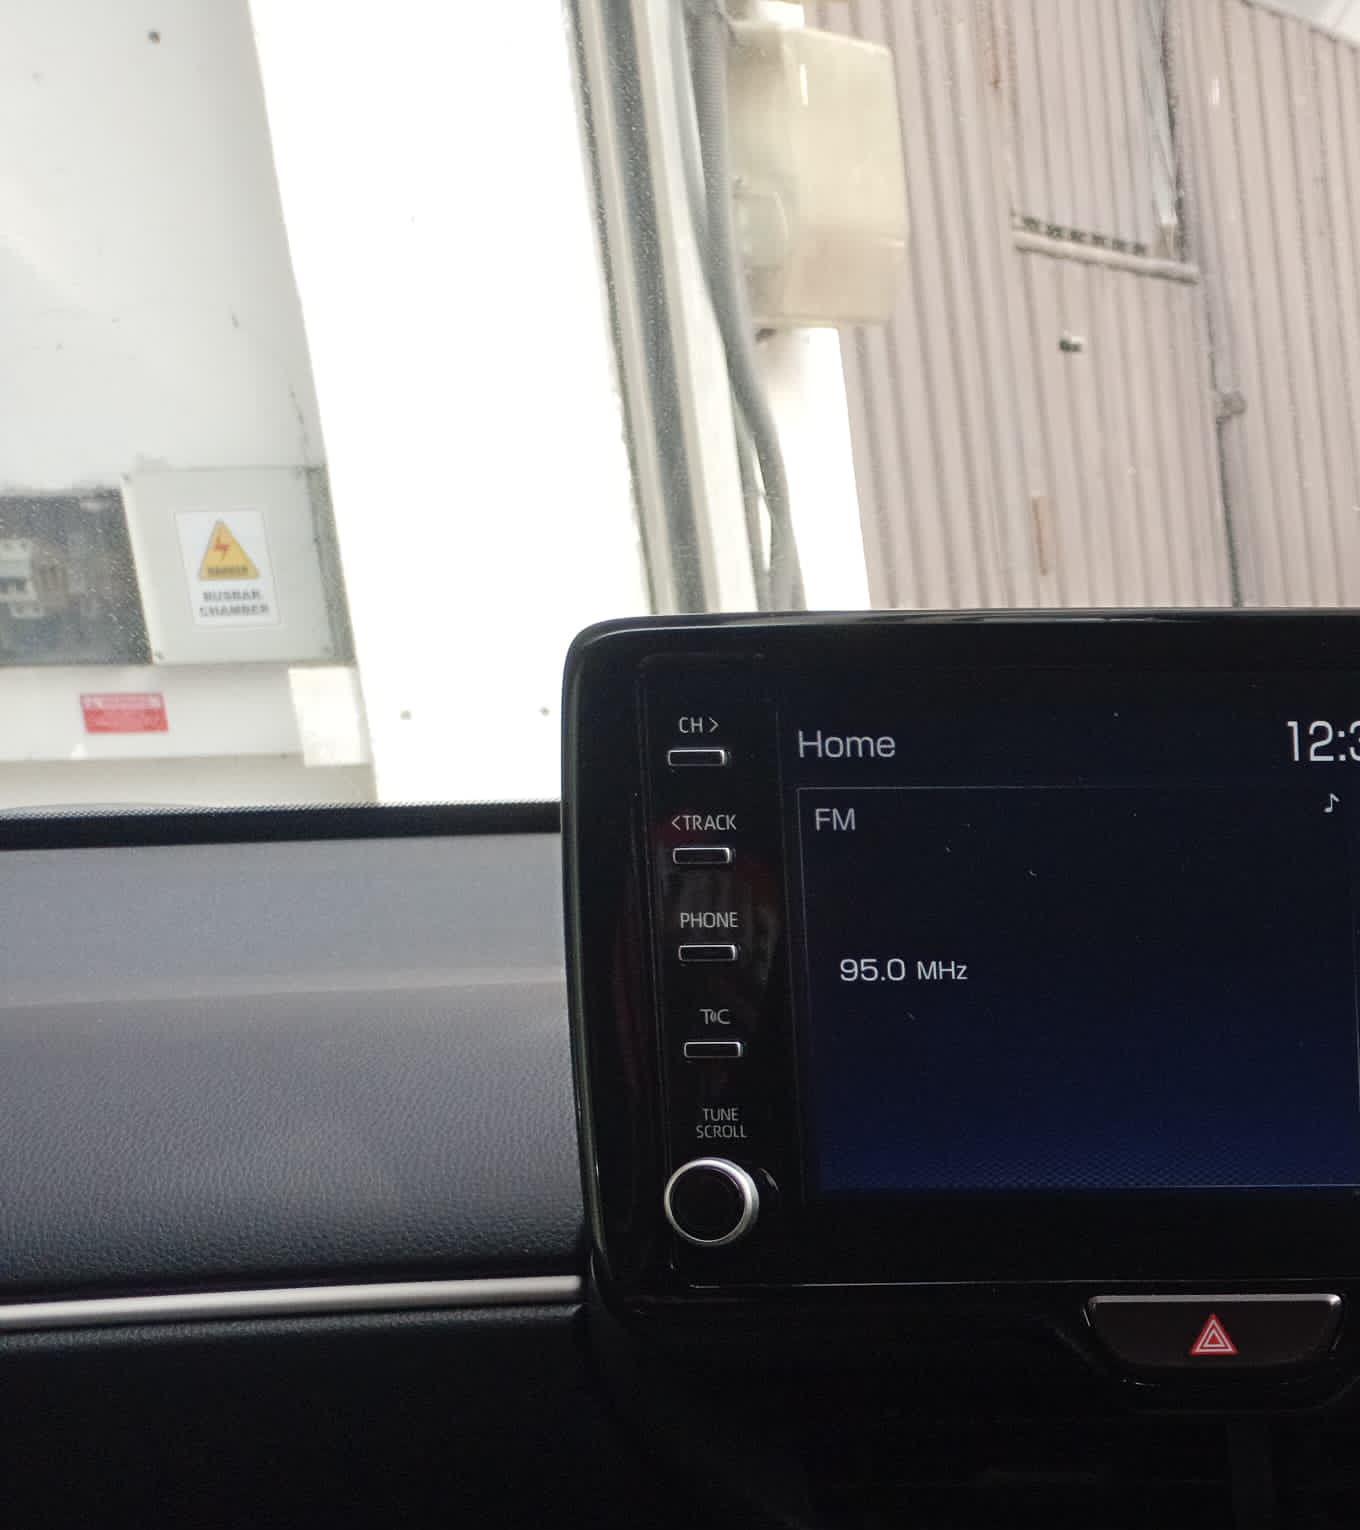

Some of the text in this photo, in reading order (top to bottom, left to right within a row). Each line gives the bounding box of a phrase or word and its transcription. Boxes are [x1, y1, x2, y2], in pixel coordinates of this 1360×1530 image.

[797, 730, 897, 759] Home
[814, 807, 857, 831] FM
[679, 911, 740, 929] PHONE
[838, 957, 969, 983] 95.0 MHz
[702, 1107, 740, 1122] TUNE
[695, 1124, 747, 1139] SCROLL
